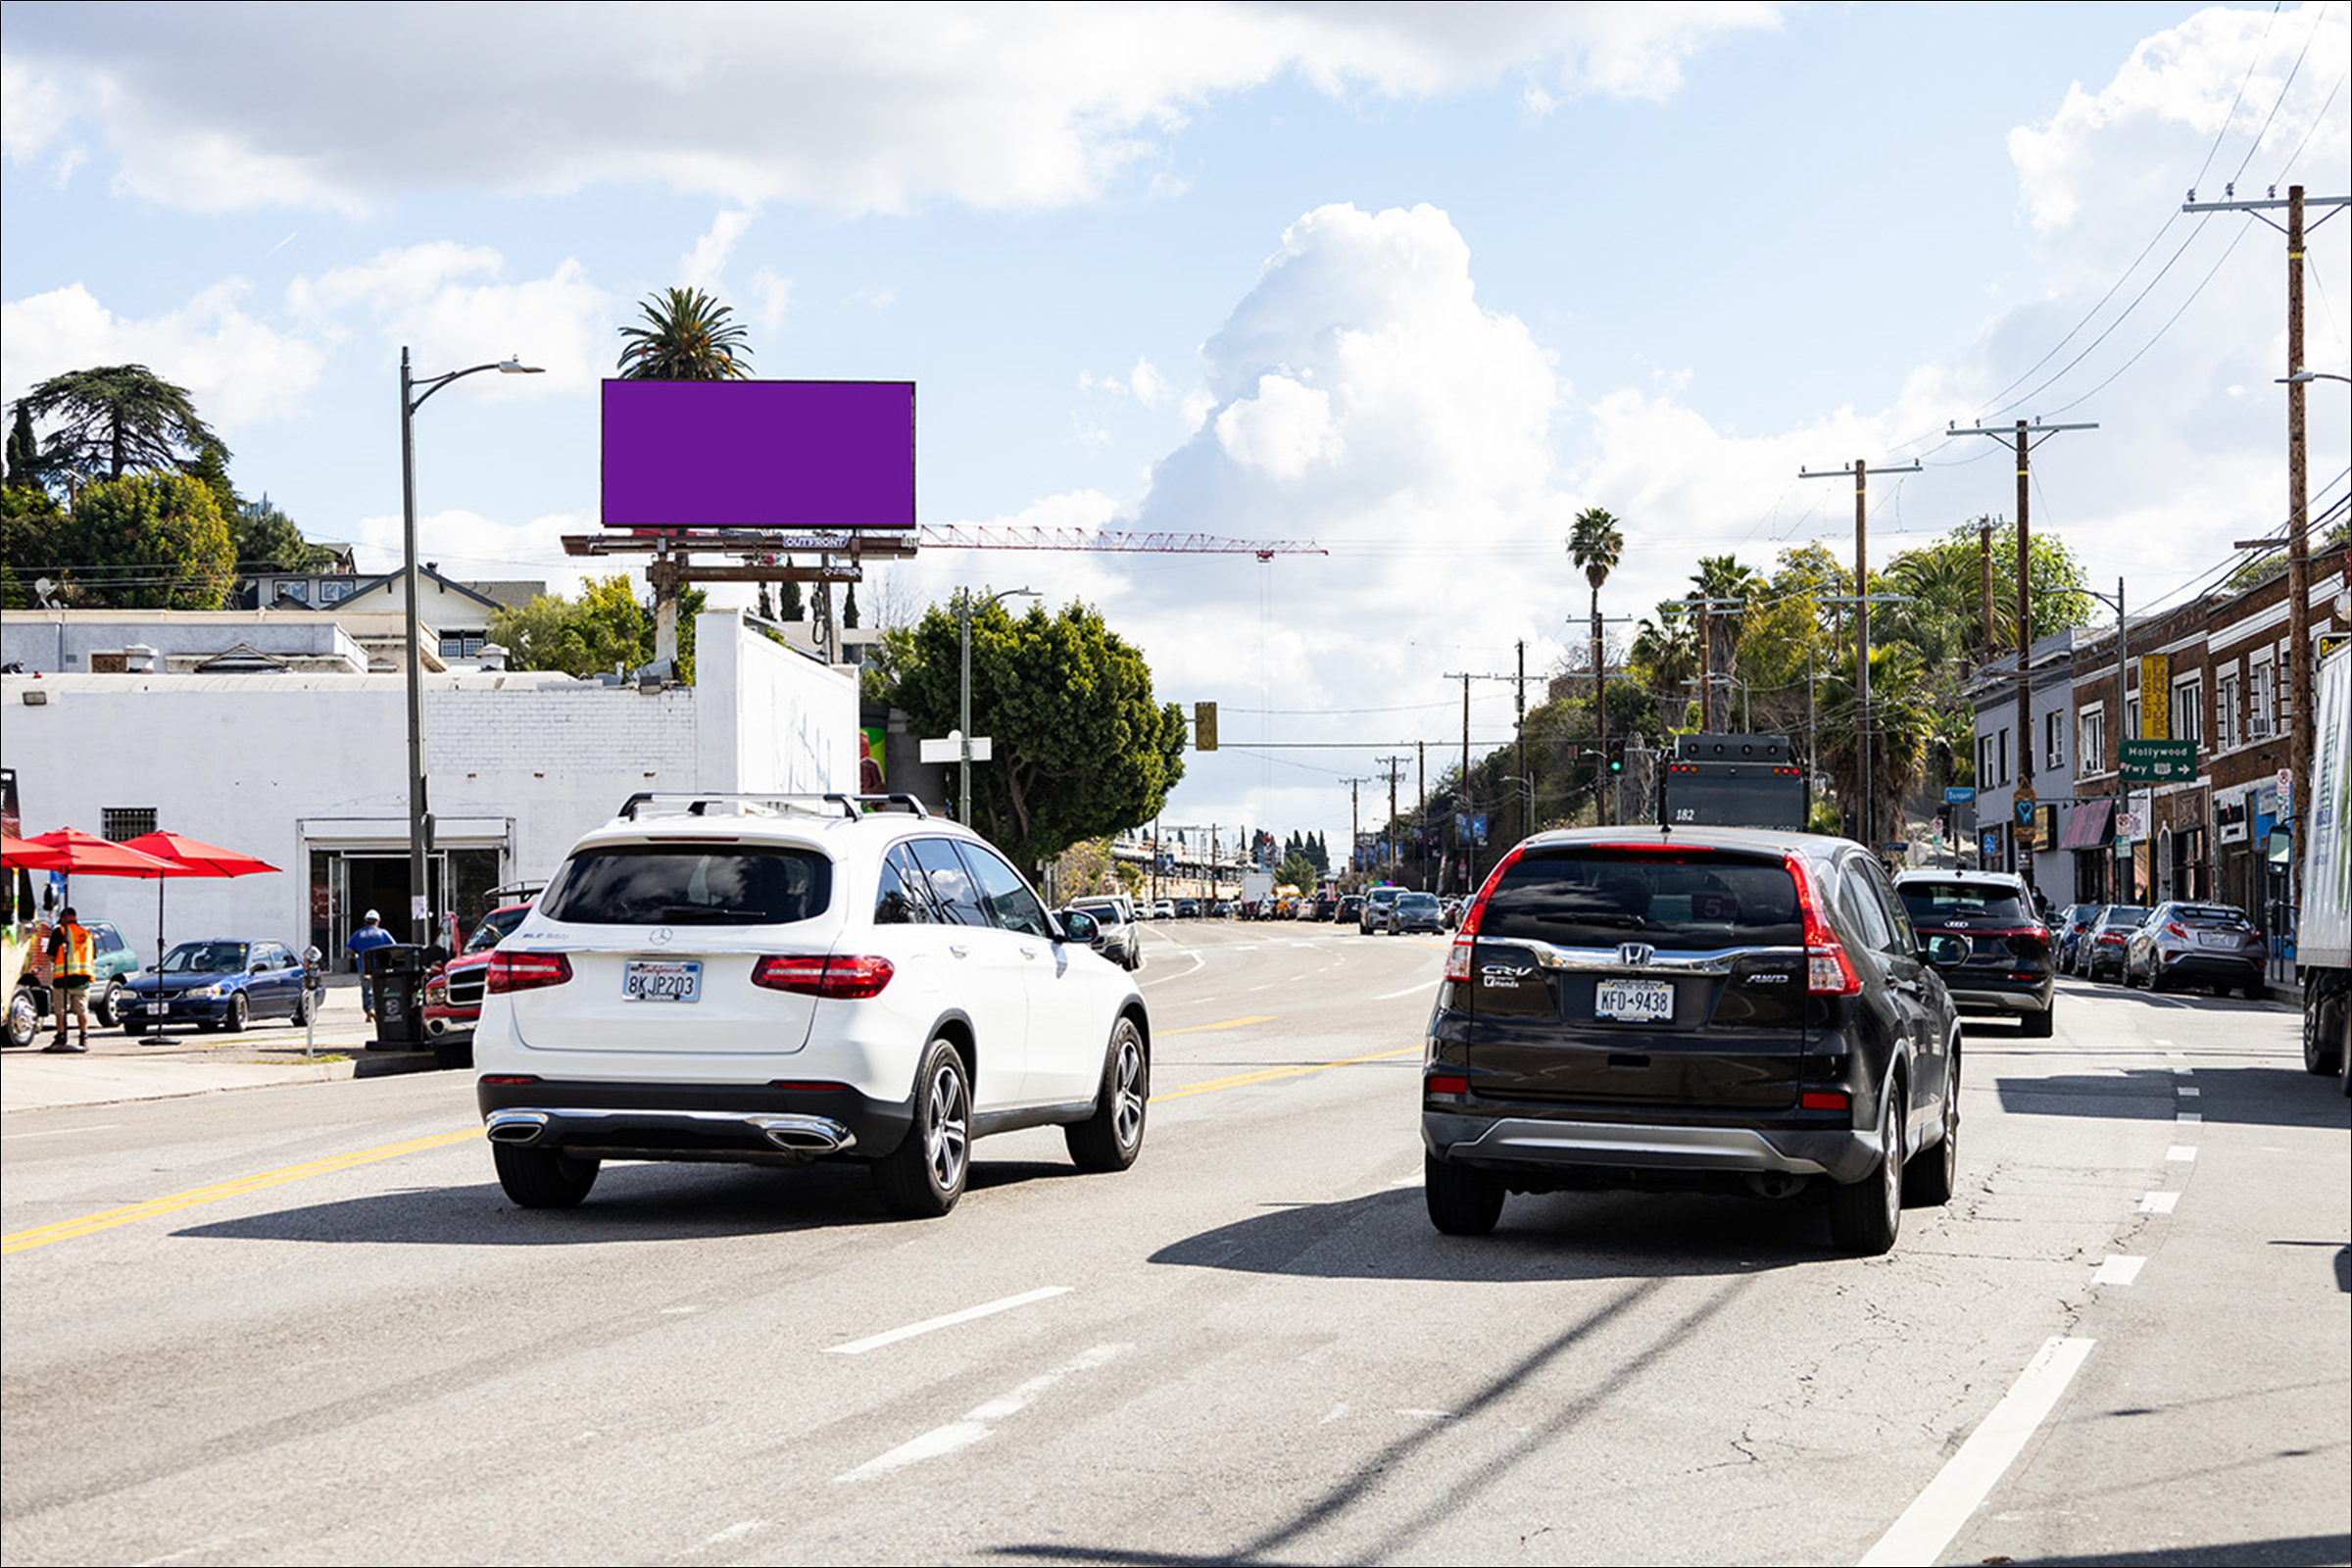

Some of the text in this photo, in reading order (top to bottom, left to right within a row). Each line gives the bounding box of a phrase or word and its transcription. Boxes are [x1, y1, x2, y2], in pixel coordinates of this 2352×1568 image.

[785, 538, 845, 547] OUTFRONT
[2129, 747, 2187, 759] Hollywood
[1676, 808, 1694, 820] 182
[1746, 974, 1788, 983] AWD
[628, 976, 694, 995] 8KJP203
